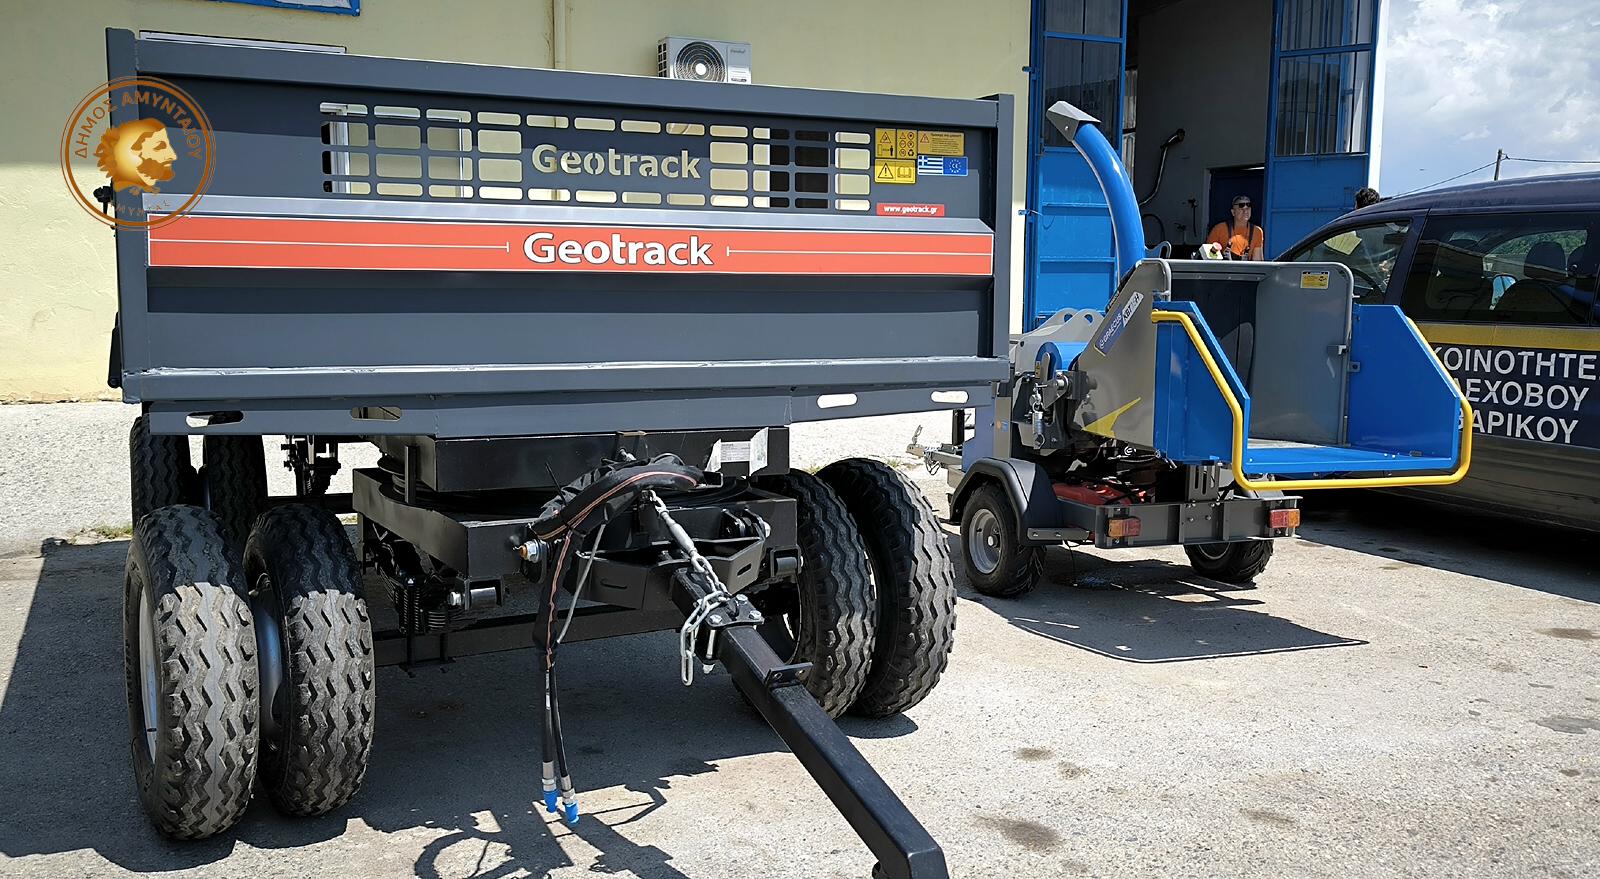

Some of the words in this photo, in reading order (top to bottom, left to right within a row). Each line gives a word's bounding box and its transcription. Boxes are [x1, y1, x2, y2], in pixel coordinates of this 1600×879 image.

[531, 144, 701, 179] Geotrack
[883, 205, 937, 215] www.geotrack.gr
[523, 232, 714, 266] Geotrack
[1433, 346, 1600, 381] ΟΙΝΟΤΗΤΕ
[1454, 377, 1590, 411] ΕΧΟΒΟΥ
